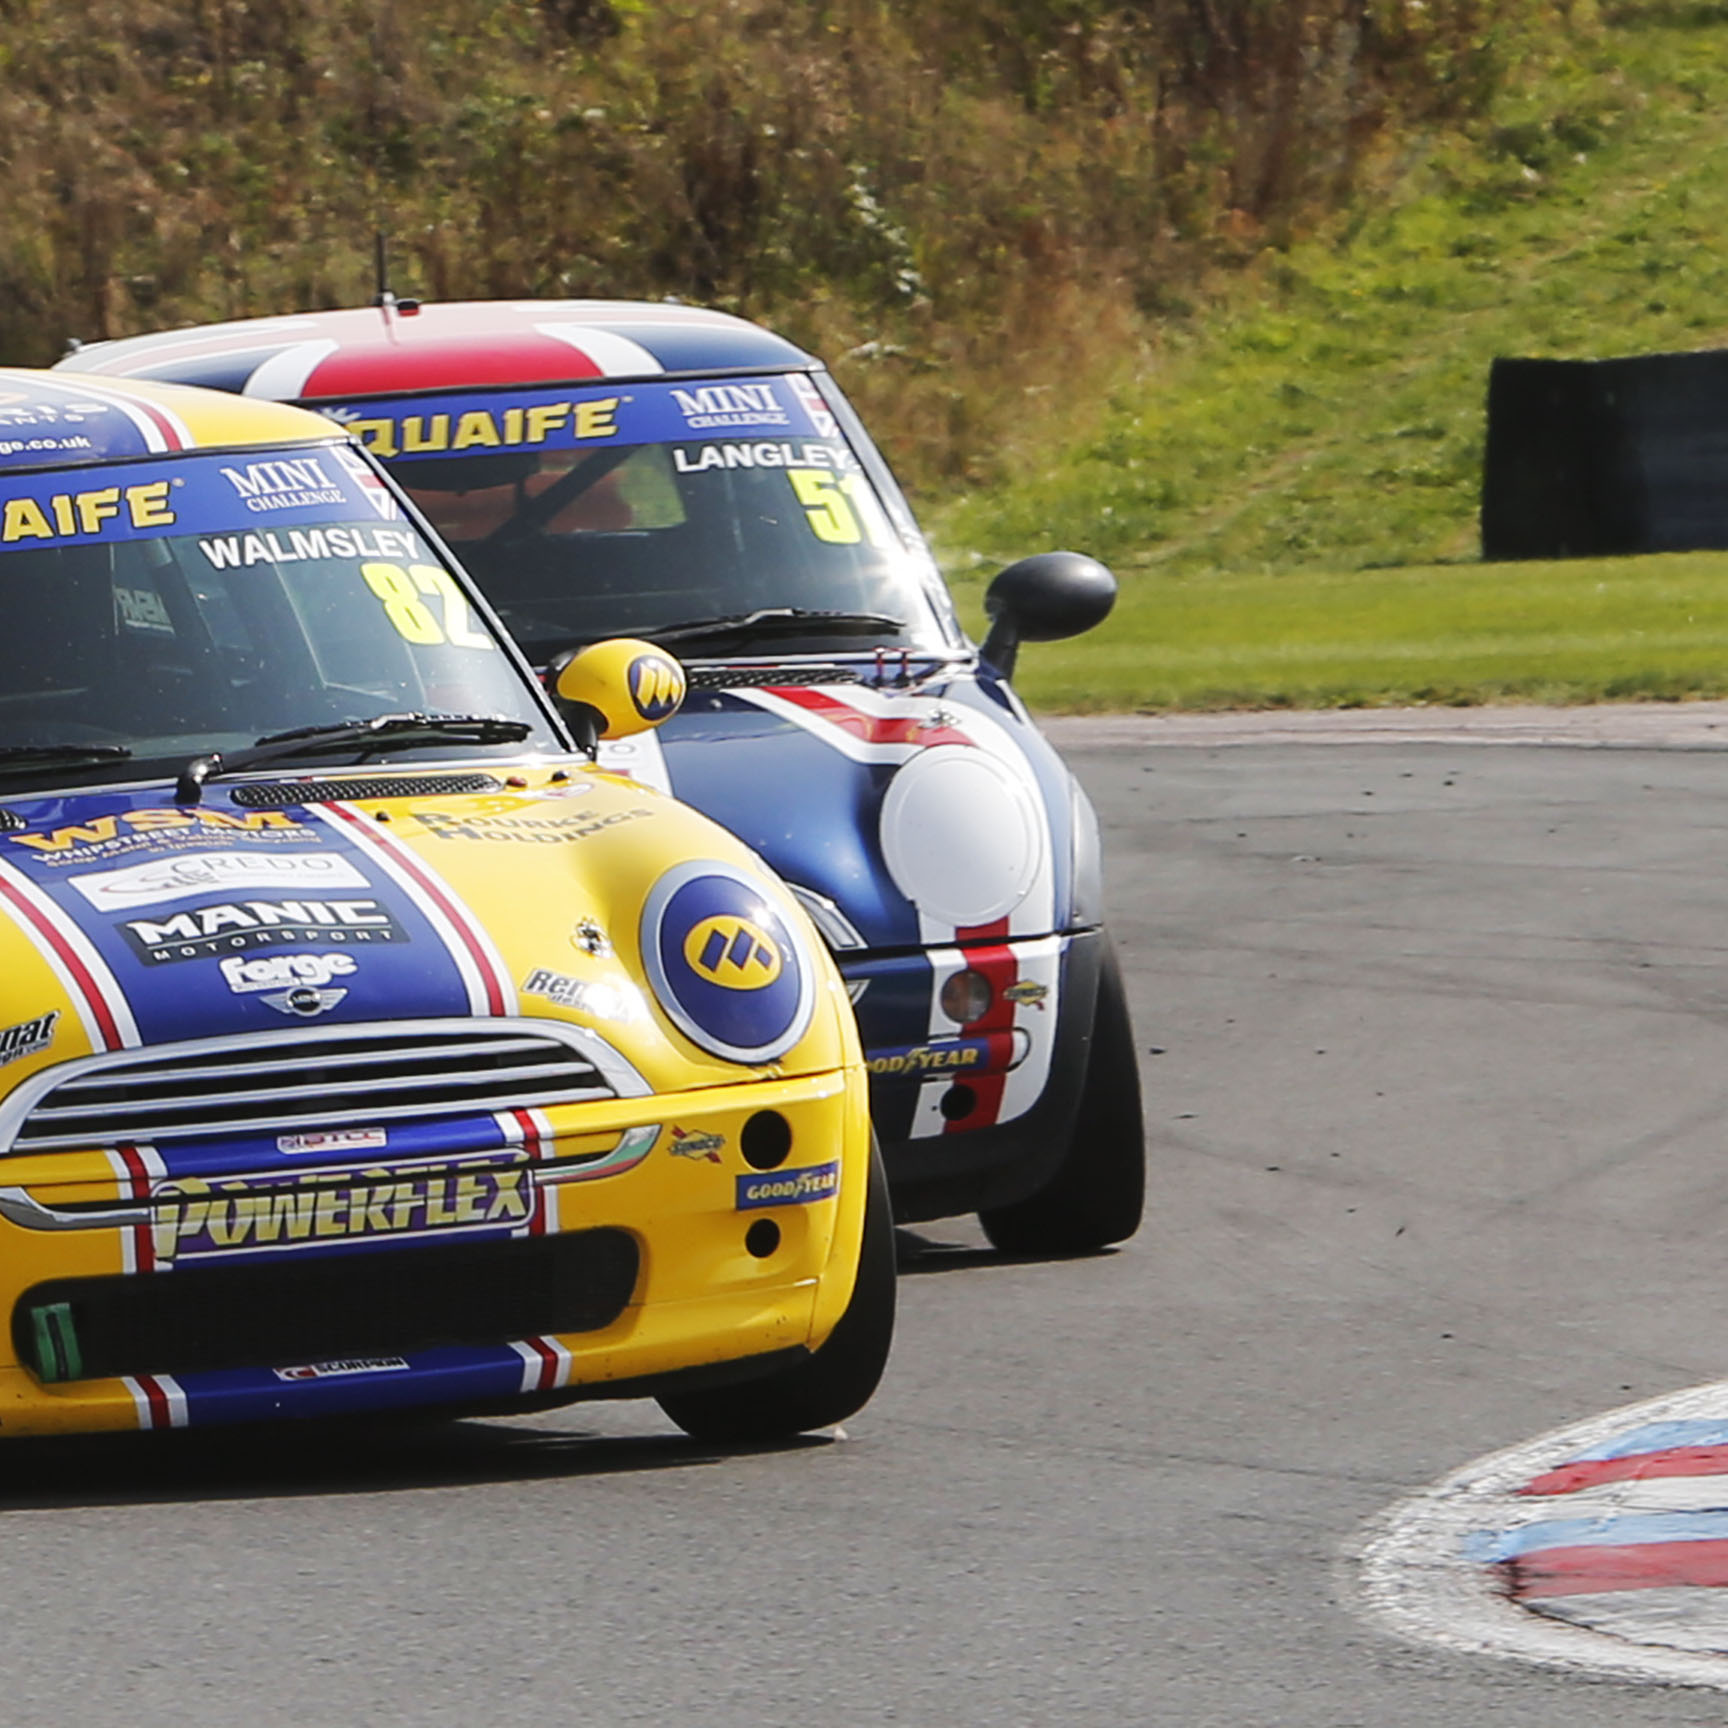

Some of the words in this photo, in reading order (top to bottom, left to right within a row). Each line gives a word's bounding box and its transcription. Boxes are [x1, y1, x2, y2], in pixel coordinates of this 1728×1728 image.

[671, 384, 786, 416] MINI
[686, 409, 790, 428] CHALLENGE
[346, 396, 619, 456] QUAIFE
[674, 442, 848, 474] LANGLEY
[219, 457, 337, 498] MINI
[245, 488, 347, 513] CHALLENGE
[199, 527, 420, 570] WALMSLEY
[360, 561, 495, 650] 82
[8, 807, 306, 853] WSM
[32, 826, 192, 863] WHIPSTREET
[428, 808, 656, 845] HOLDINGS
[170, 855, 334, 875] CREDO
[126, 900, 390, 945] MANIC
[152, 929, 394, 962] MOTORSPORT
[219, 952, 359, 990] forge
[746, 1172, 836, 1199] GOODYEAR
[154, 1151, 530, 1262] POWERFLEX
